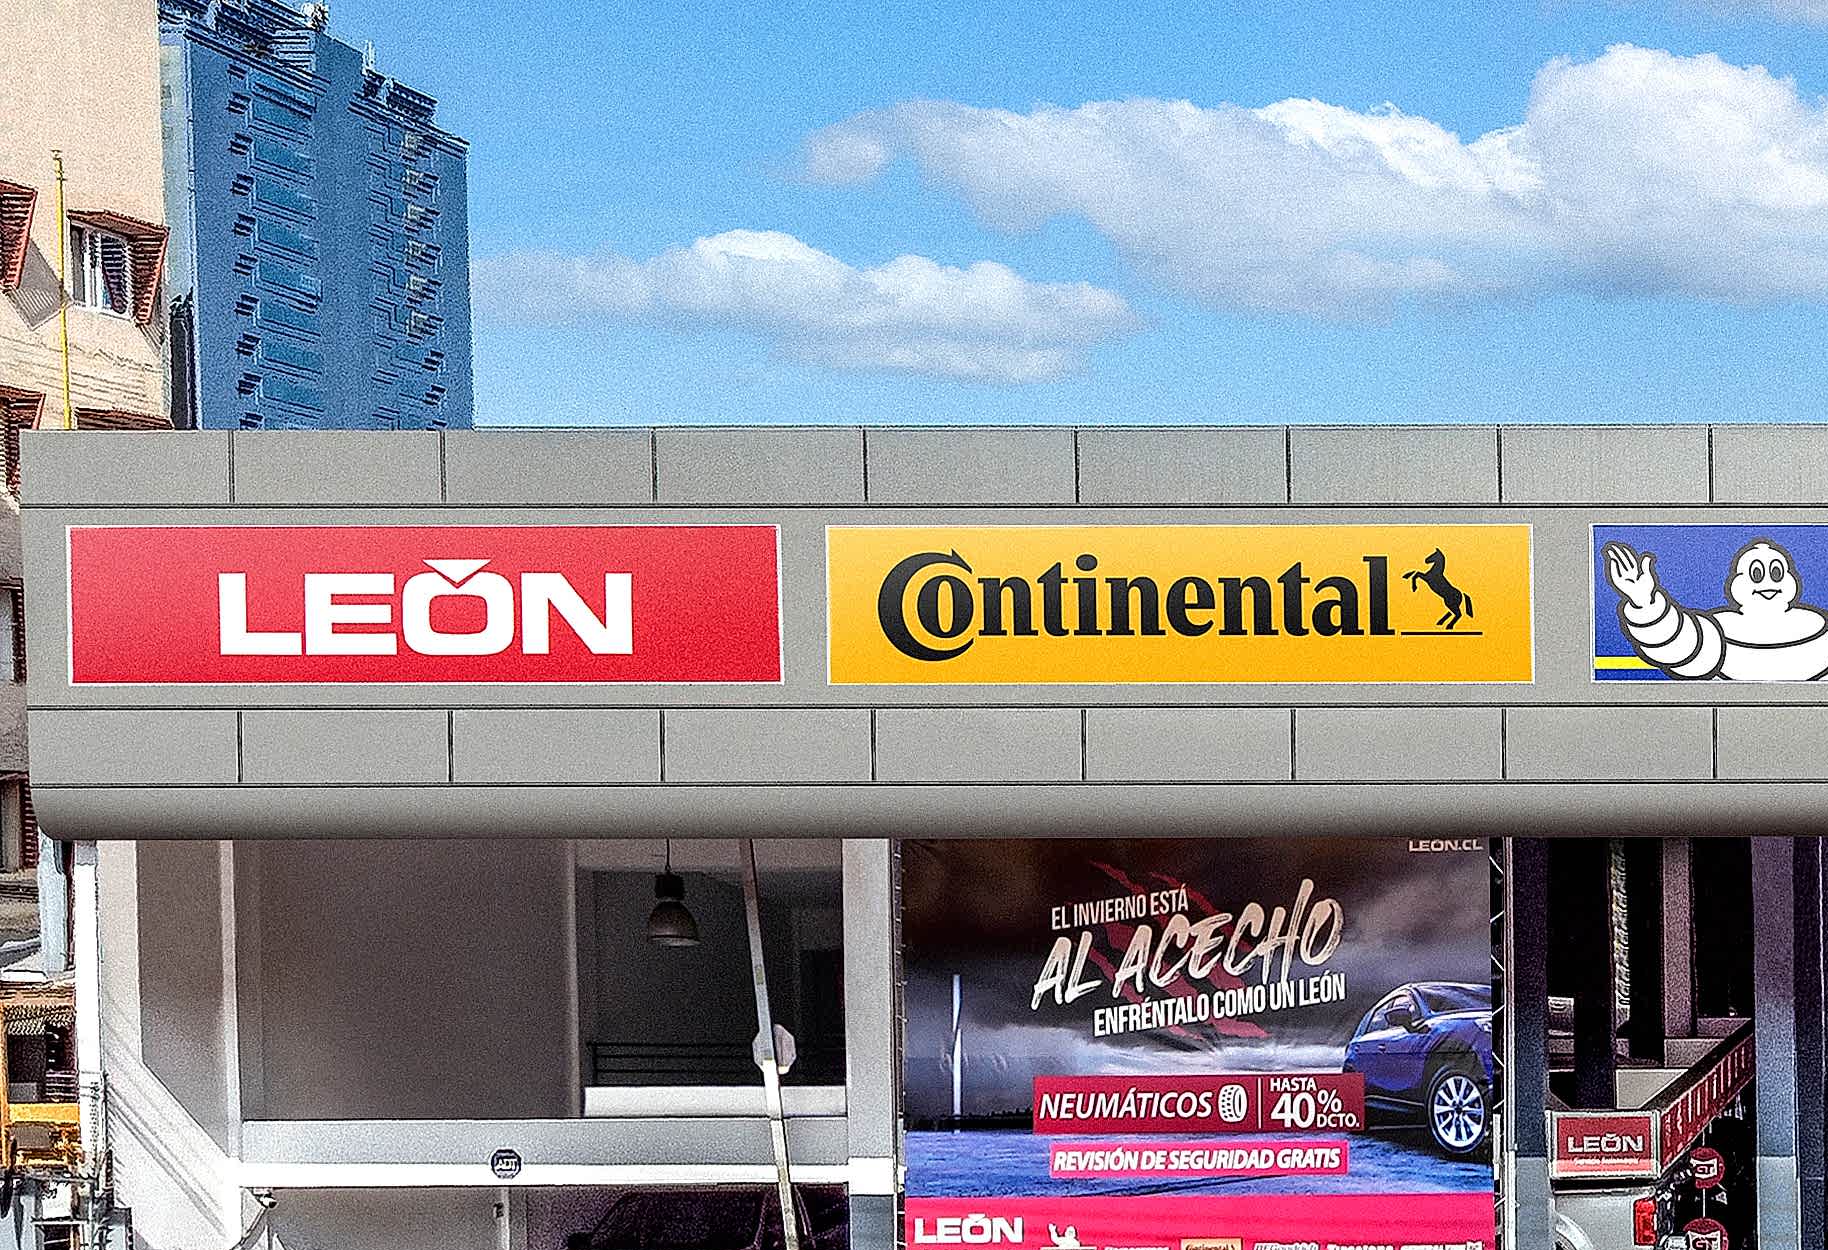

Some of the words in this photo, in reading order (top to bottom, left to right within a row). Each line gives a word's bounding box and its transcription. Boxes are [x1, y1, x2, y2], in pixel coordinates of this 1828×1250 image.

[877, 548, 1399, 662] Continental
[1052, 906, 1070, 930] EL
[1073, 894, 1147, 926] INVIERNO
[1150, 884, 1189, 916] ESTÁ
[1031, 931, 1101, 1010] AL
[1112, 878, 1344, 998] ACECHO
[1094, 992, 1210, 1038] ENFRÉNTALO
[1213, 984, 1266, 1019] COMO
[1269, 979, 1296, 1012] UN
[1299, 970, 1346, 1006] LEÓN
[1039, 1087, 1213, 1119] NEUMÁTICOS
[1270, 1077, 1317, 1093] HASTA
[1317, 1112, 1360, 1128] DCTO.
[1053, 1146, 1141, 1172] REVISIÓN
[1142, 1150, 1167, 1170] DE
[1168, 1148, 1276, 1171] SEGURIDAD
[1276, 1147, 1341, 1169] GRATIS
